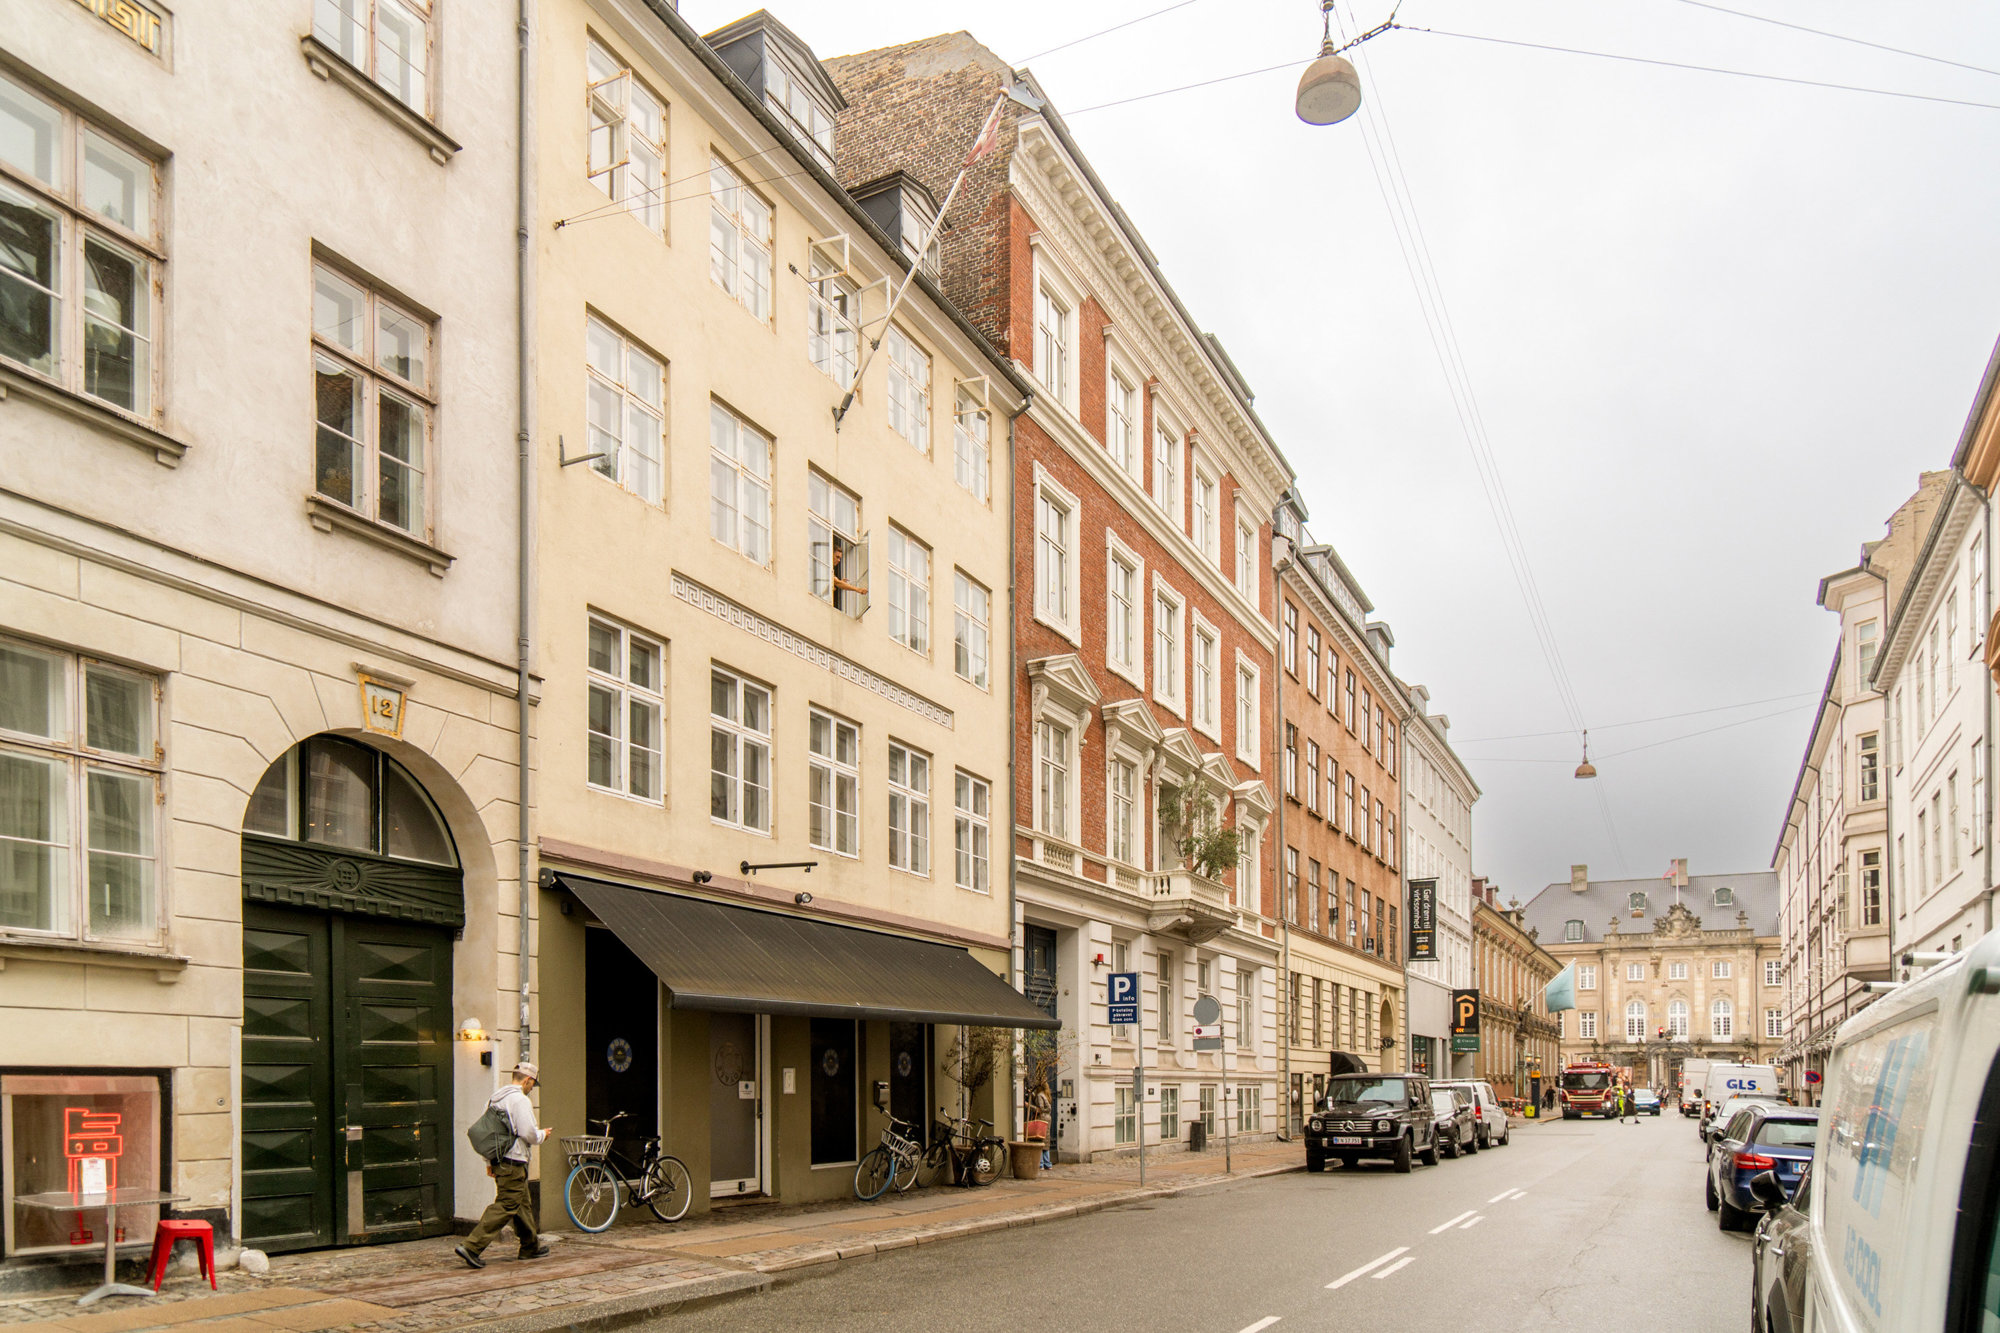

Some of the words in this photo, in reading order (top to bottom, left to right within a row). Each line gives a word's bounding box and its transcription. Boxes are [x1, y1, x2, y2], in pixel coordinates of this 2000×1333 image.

[372, 695, 393, 719] 12
[1413, 888, 1422, 929] virksomhed
[1114, 976, 1130, 1002] P
[1460, 1002, 1475, 1027] P
